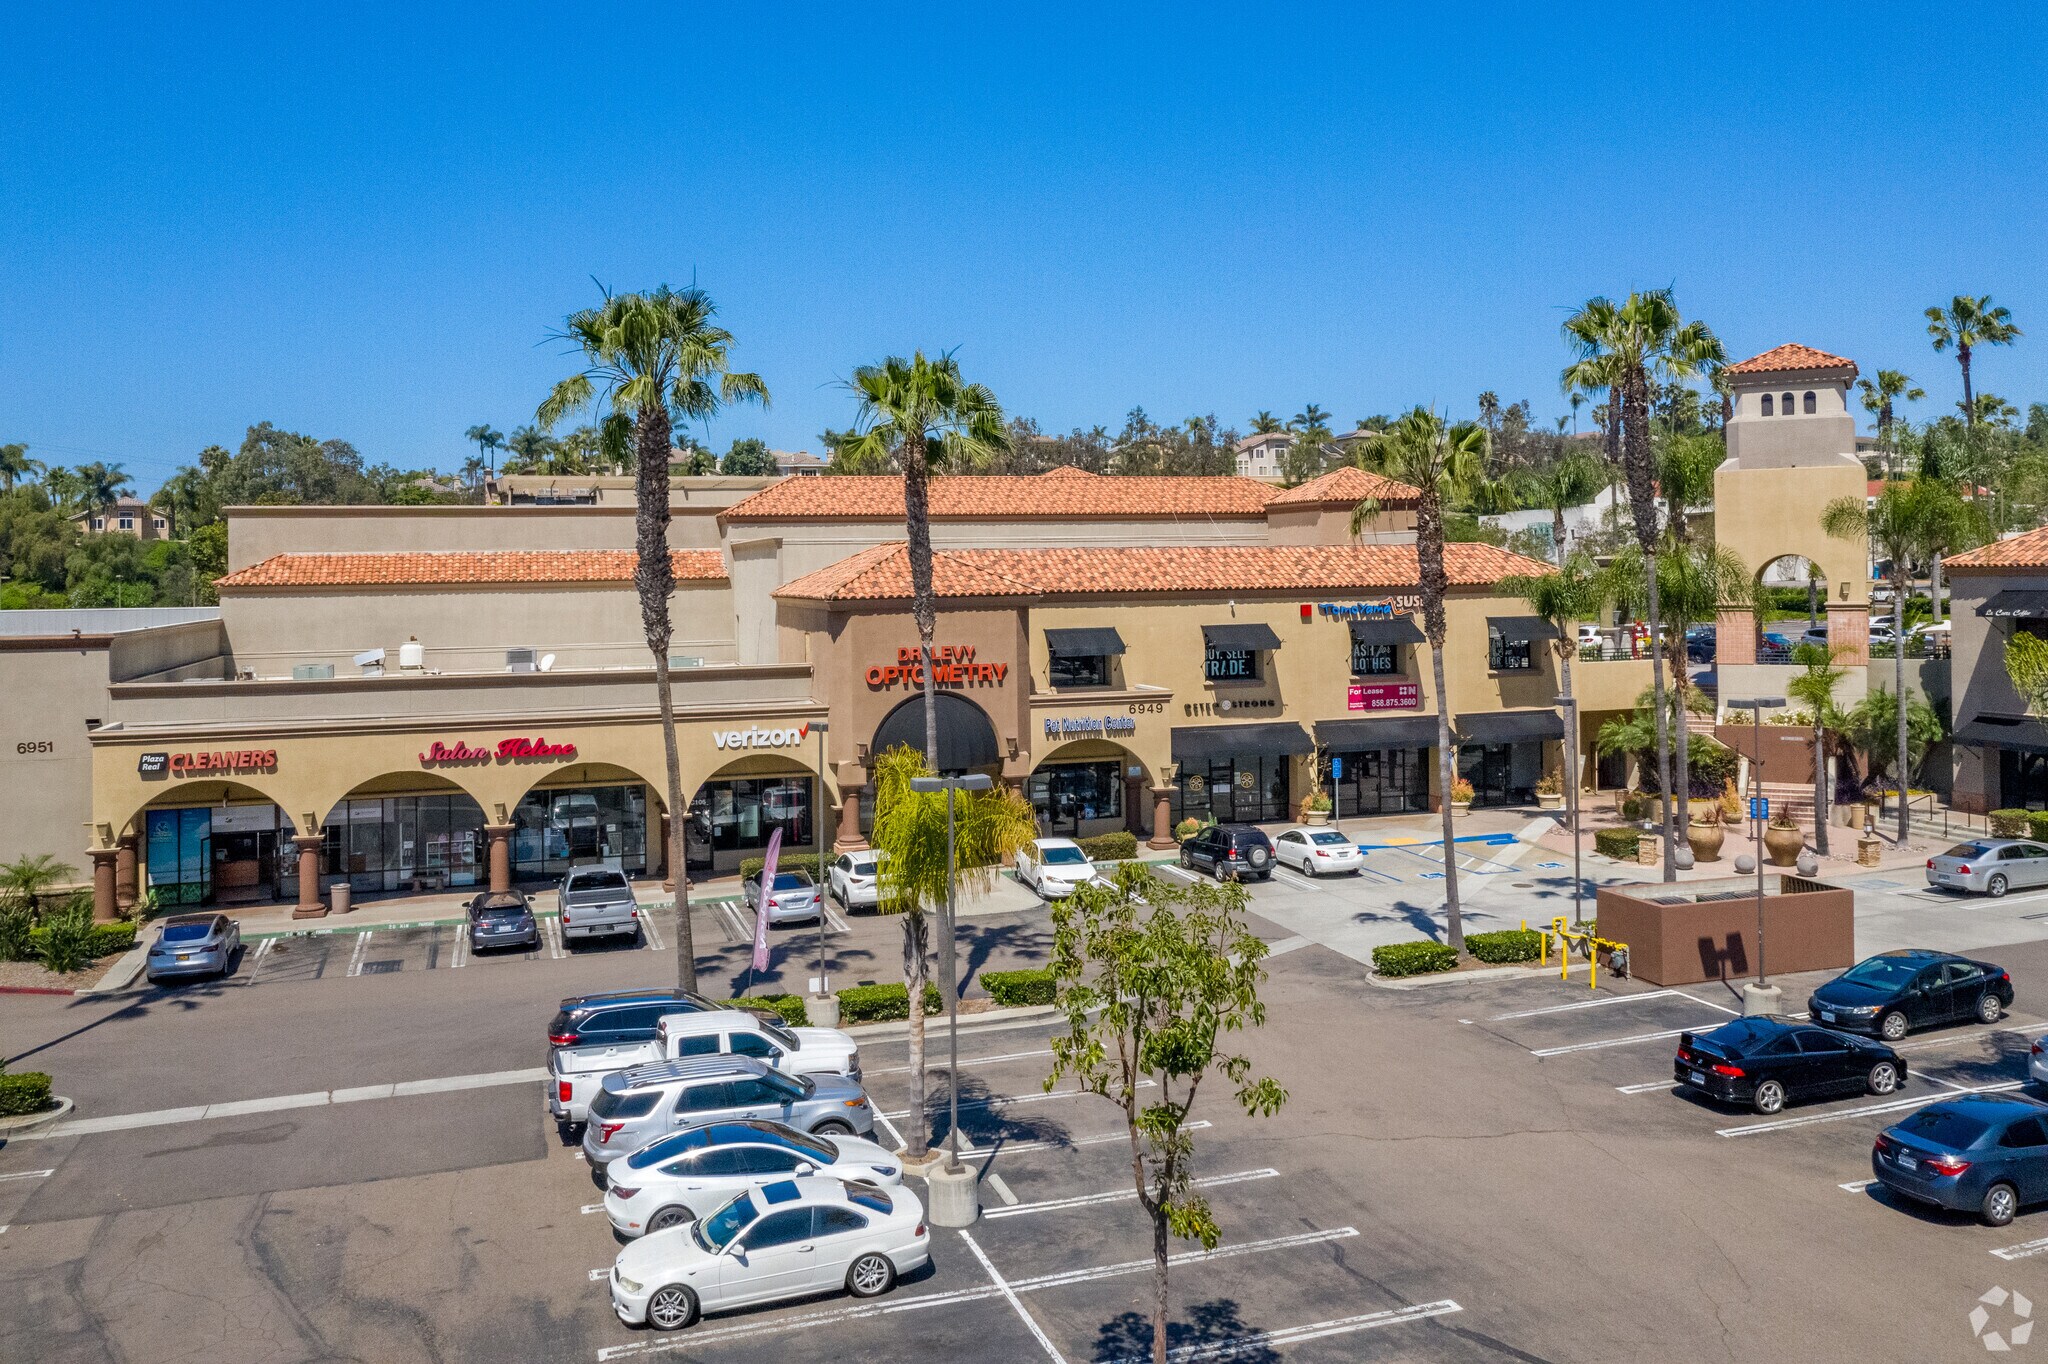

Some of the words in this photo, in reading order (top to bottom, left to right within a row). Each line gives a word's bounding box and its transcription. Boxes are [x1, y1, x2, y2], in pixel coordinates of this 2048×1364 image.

[1396, 595, 1423, 607] SUS
[931, 645, 976, 660] LEVY
[865, 663, 1008, 684] OPTOMETRY
[1129, 703, 1163, 714] 6949
[1371, 698, 1417, 707] 858.875.3600
[1044, 718, 1060, 732] Pet
[1062, 716, 1102, 732] Nutrition
[1104, 715, 1135, 730] Center
[713, 725, 801, 748] verizon
[16, 741, 53, 754] 6951
[418, 740, 489, 762] Salon
[494, 737, 576, 758] Helene
[142, 755, 164, 763] Plaza
[169, 749, 276, 770] CLEANERS
